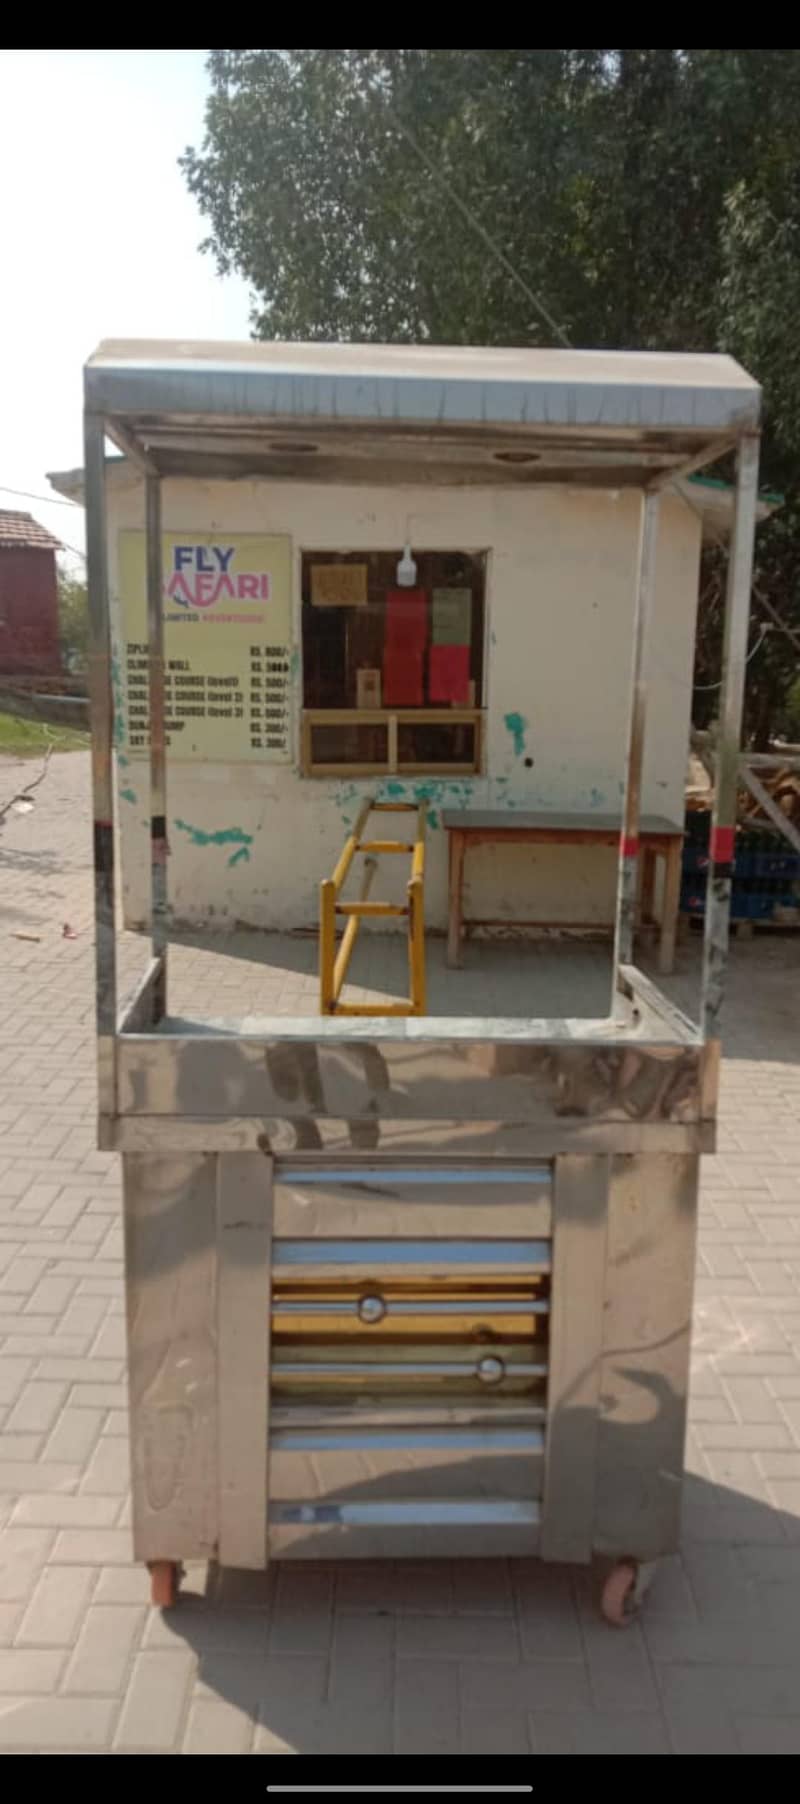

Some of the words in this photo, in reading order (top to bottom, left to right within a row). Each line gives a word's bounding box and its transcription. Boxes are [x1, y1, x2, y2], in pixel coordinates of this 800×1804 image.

[173, 545, 235, 573] FLY
[162, 572, 269, 608] AFARI
[162, 613, 199, 622] LIMITED
